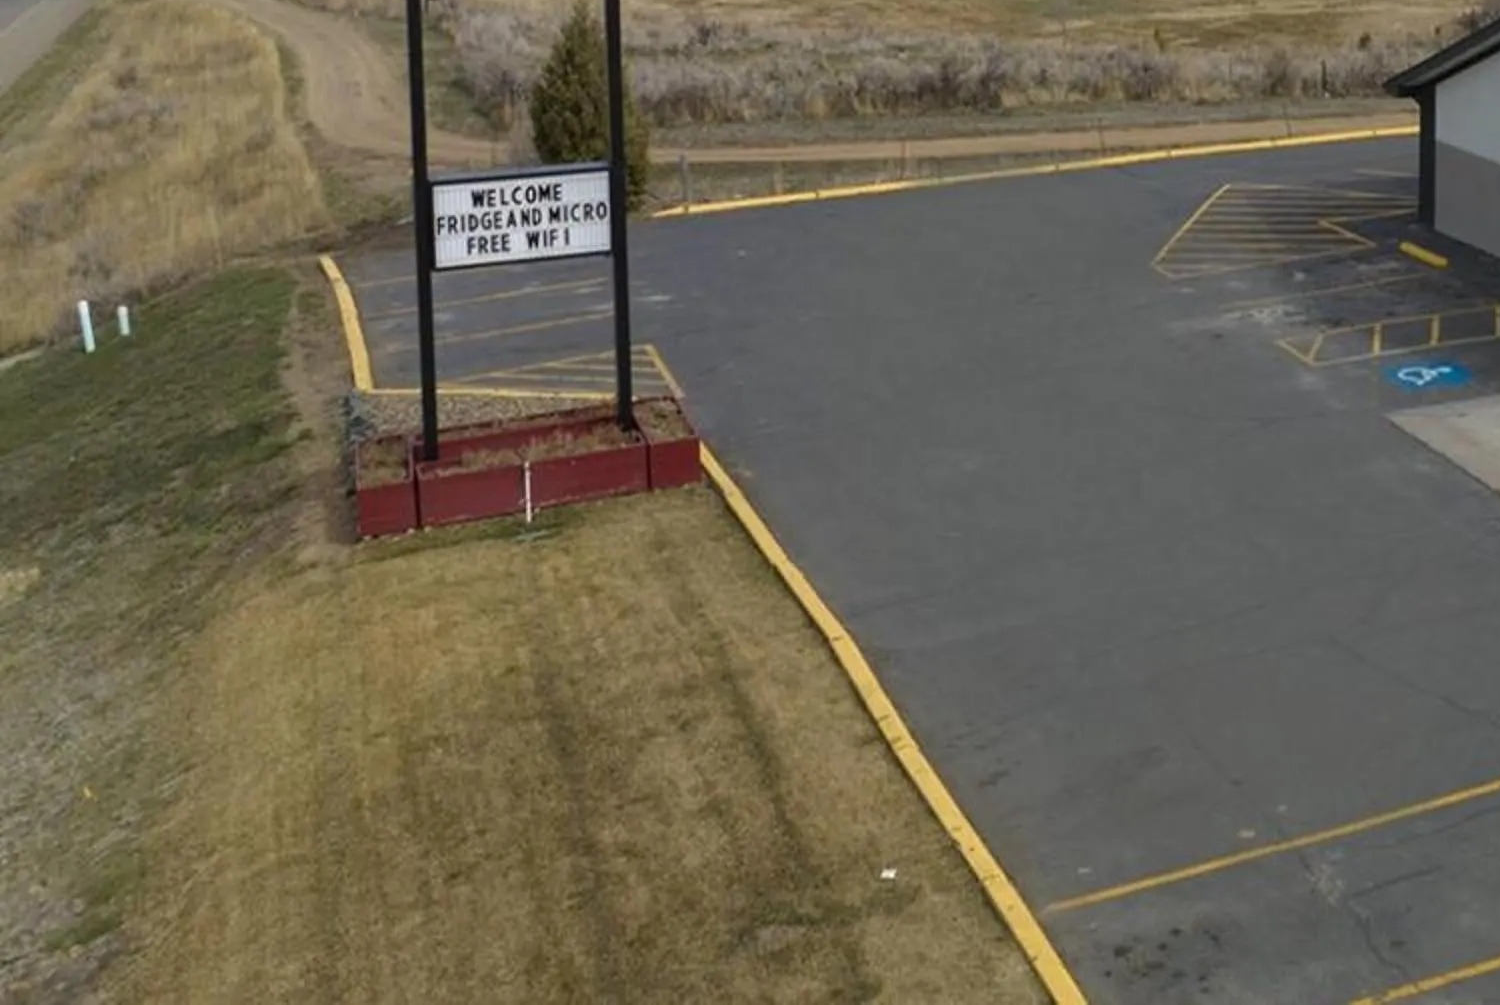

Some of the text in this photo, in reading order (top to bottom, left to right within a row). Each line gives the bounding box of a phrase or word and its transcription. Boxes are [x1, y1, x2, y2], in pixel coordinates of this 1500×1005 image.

[471, 183, 563, 207] WELCOME
[549, 201, 607, 224] MICRO
[466, 228, 570, 255] FREE WIFI
